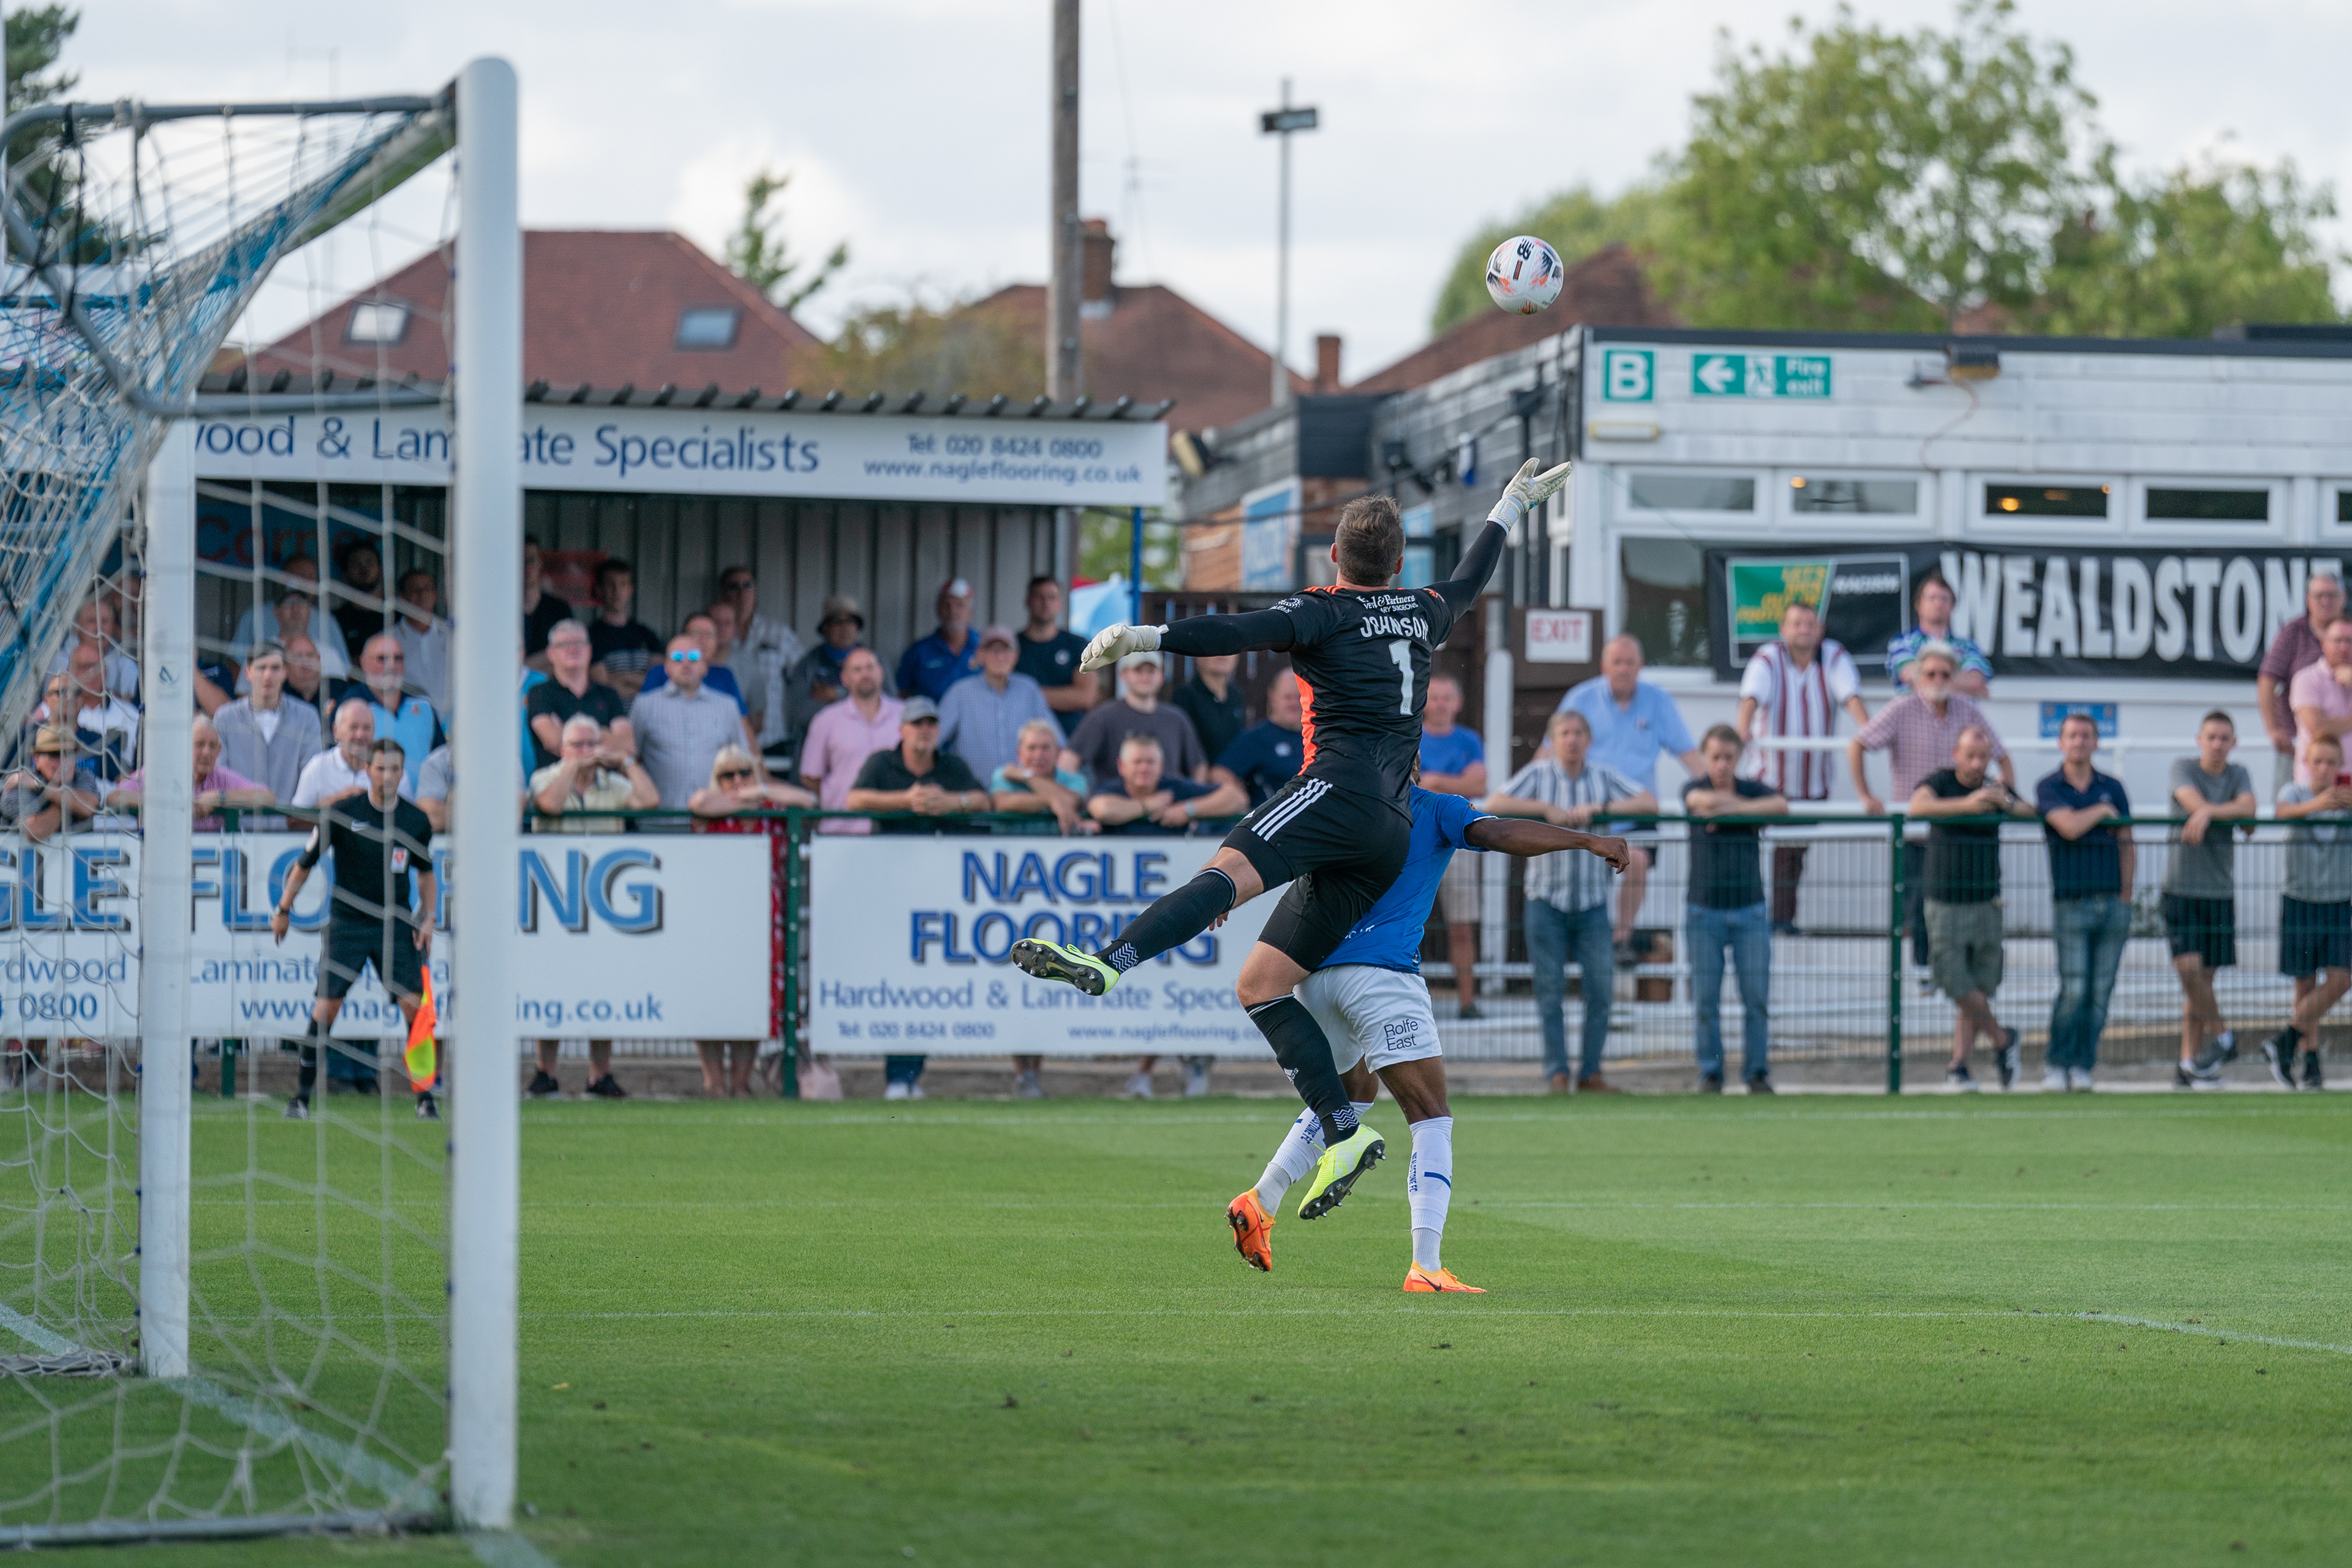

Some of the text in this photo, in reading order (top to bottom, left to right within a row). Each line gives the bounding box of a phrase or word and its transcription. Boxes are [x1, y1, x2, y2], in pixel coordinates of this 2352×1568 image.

[1609, 353, 1650, 398] B
[1785, 358, 1827, 377] Fire
[1785, 378, 1825, 396] exit
[316, 417, 352, 459] &
[594, 424, 820, 479] Specialists
[945, 434, 983, 456] 020
[990, 435, 1041, 458] 8424
[1049, 437, 1103, 459] 0800
[1384, 594, 1415, 605] Partners
[1939, 550, 2344, 663] WEALDSTON
[1360, 616, 1428, 642] JOHNSON
[1532, 618, 1583, 641] EXIT
[1389, 639, 1414, 716] 1
[962, 850, 1169, 905] NAGLE
[820, 978, 974, 1010] Hardwood
[986, 980, 1009, 1010] &
[18, 992, 98, 1022] 0800
[1384, 1019, 1419, 1038] Rolfe
[1386, 1034, 1417, 1051] East
[1409, 1184, 1418, 1193] FC
